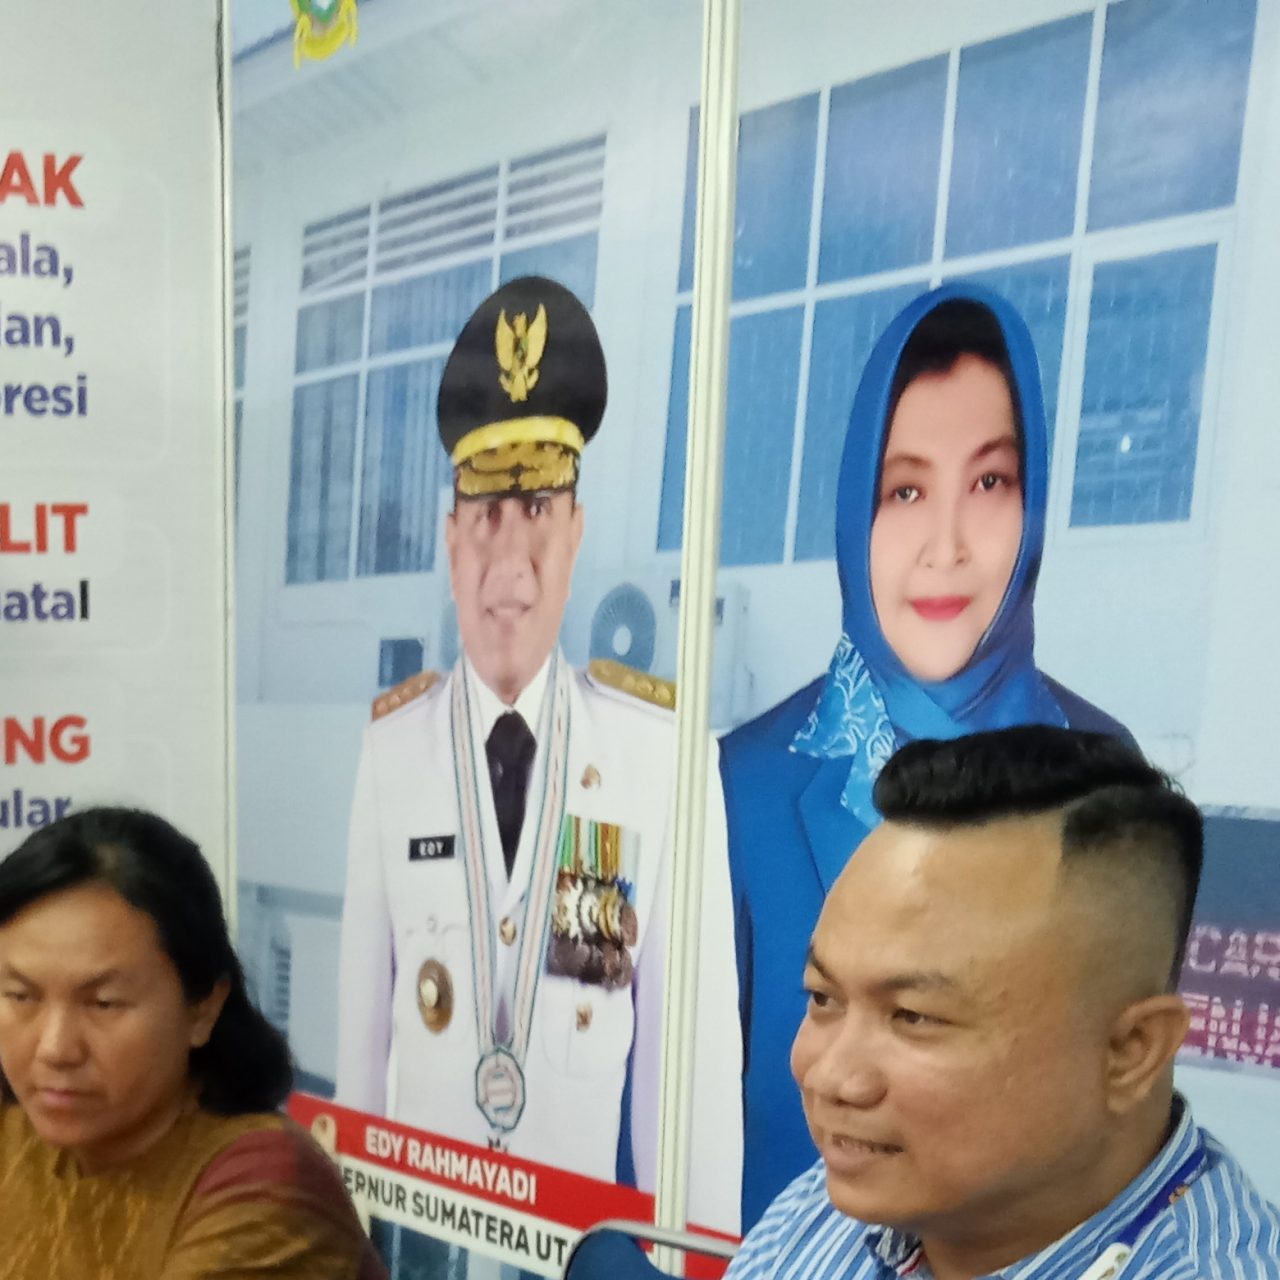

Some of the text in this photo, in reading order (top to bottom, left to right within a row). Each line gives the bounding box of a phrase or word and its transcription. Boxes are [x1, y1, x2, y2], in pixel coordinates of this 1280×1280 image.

[365, 1125, 538, 1206] EDY RAHMAYADI
[412, 1190, 531, 1257] SUMATERA
[536, 1229, 577, 1267] UT
